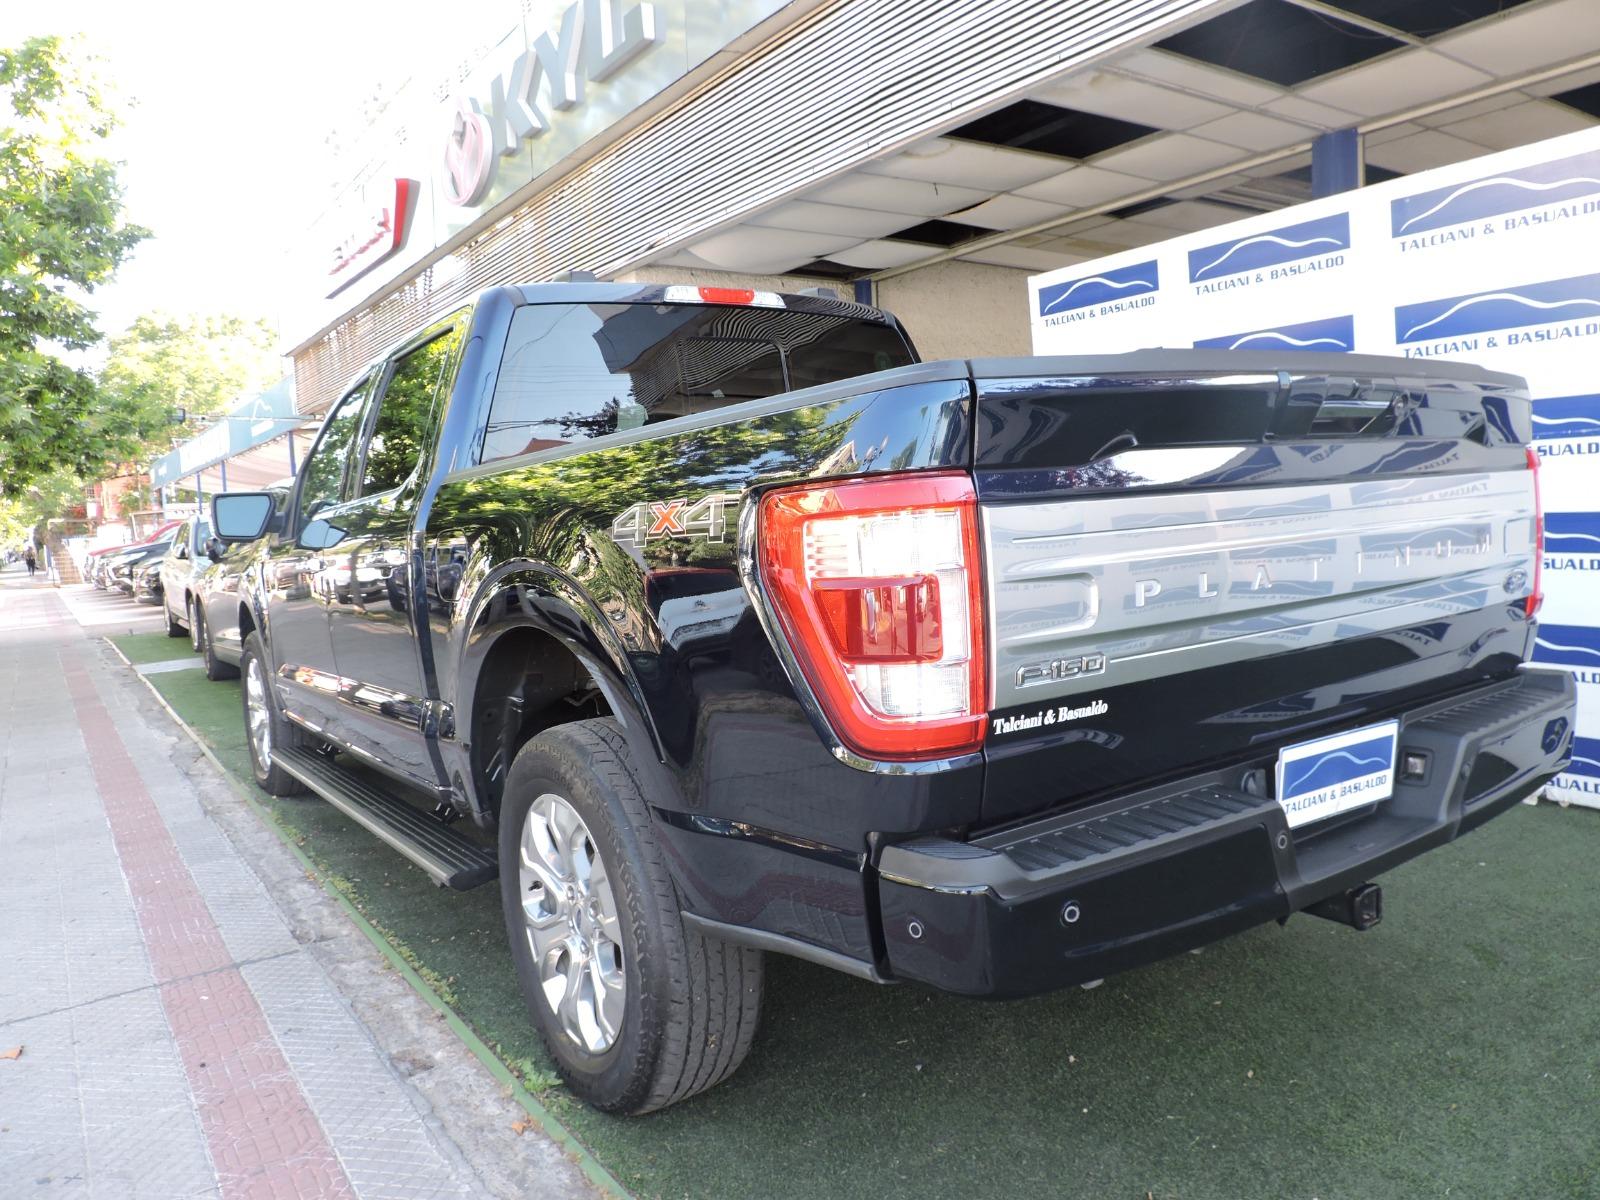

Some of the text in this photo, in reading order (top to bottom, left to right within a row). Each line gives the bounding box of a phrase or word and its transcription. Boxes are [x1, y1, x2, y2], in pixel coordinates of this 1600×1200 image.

[1400, 200, 1600, 252] TALCIANI & BASUALD
[1195, 255, 1345, 296] TALCIANI & BASUALDO
[1045, 296, 1156, 328] TALCIANI & BASUALDO
[1404, 323, 1600, 360] TALCIANI & BASUALD
[1135, 530, 1490, 607] PLATINUM
[1015, 652, 1106, 689] F-150
[993, 699, 1108, 735] Talciani & Basualdo
[1285, 774, 1387, 815] TALCIANI & BASUALDO
